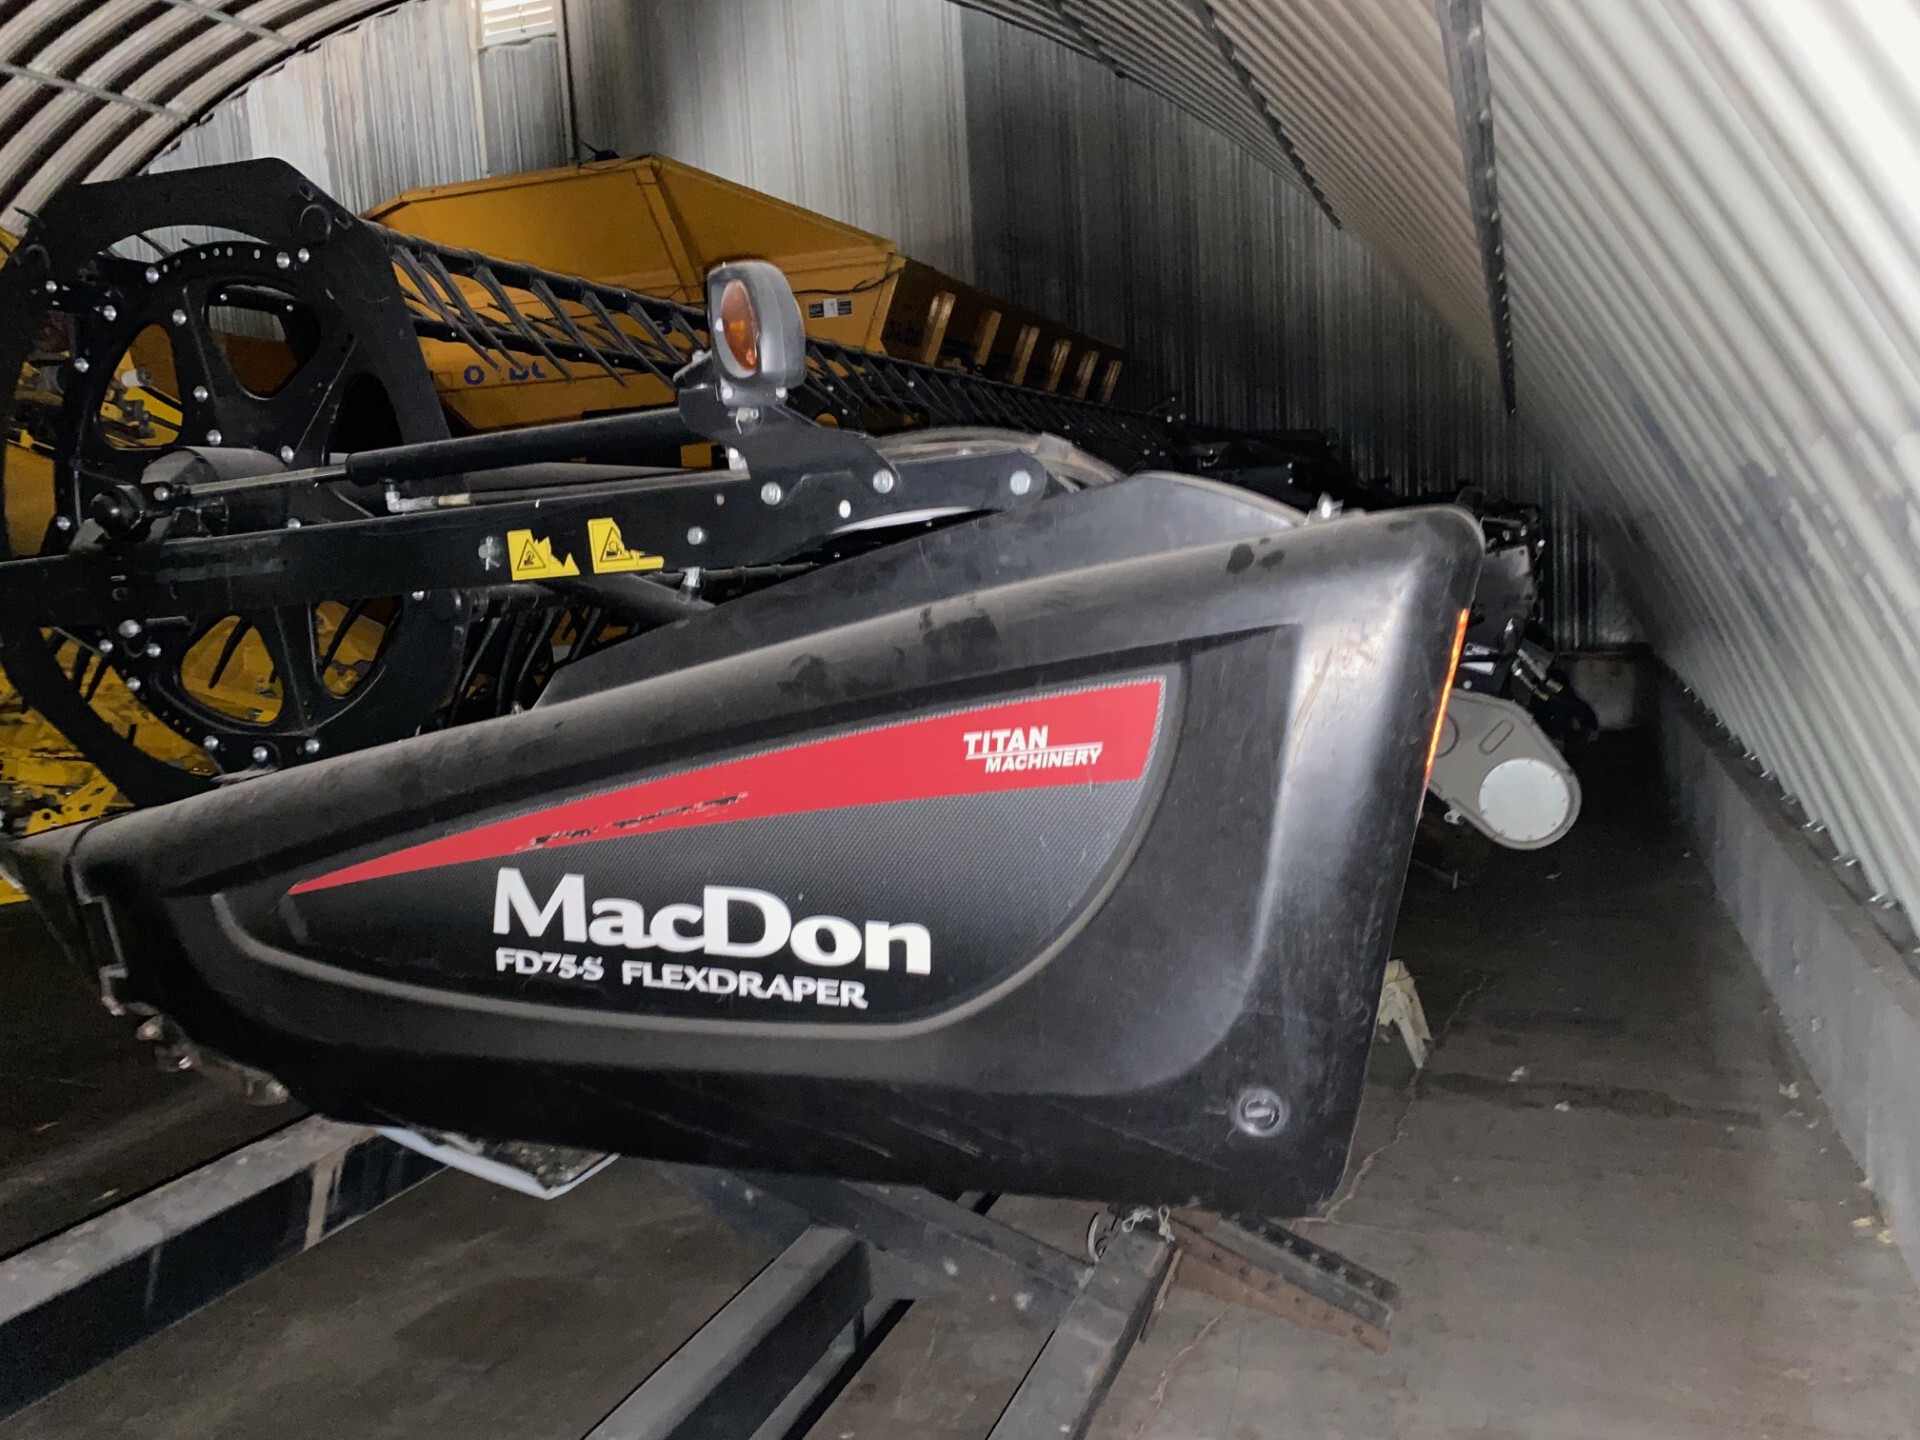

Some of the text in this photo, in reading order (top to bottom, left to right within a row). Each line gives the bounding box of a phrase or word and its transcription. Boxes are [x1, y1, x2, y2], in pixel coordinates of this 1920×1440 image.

[963, 725, 1048, 756] TITAN
[985, 746, 1103, 773] MACHINERY
[493, 867, 931, 975] MacDon
[621, 959, 868, 1009] FLEXDRAPER
